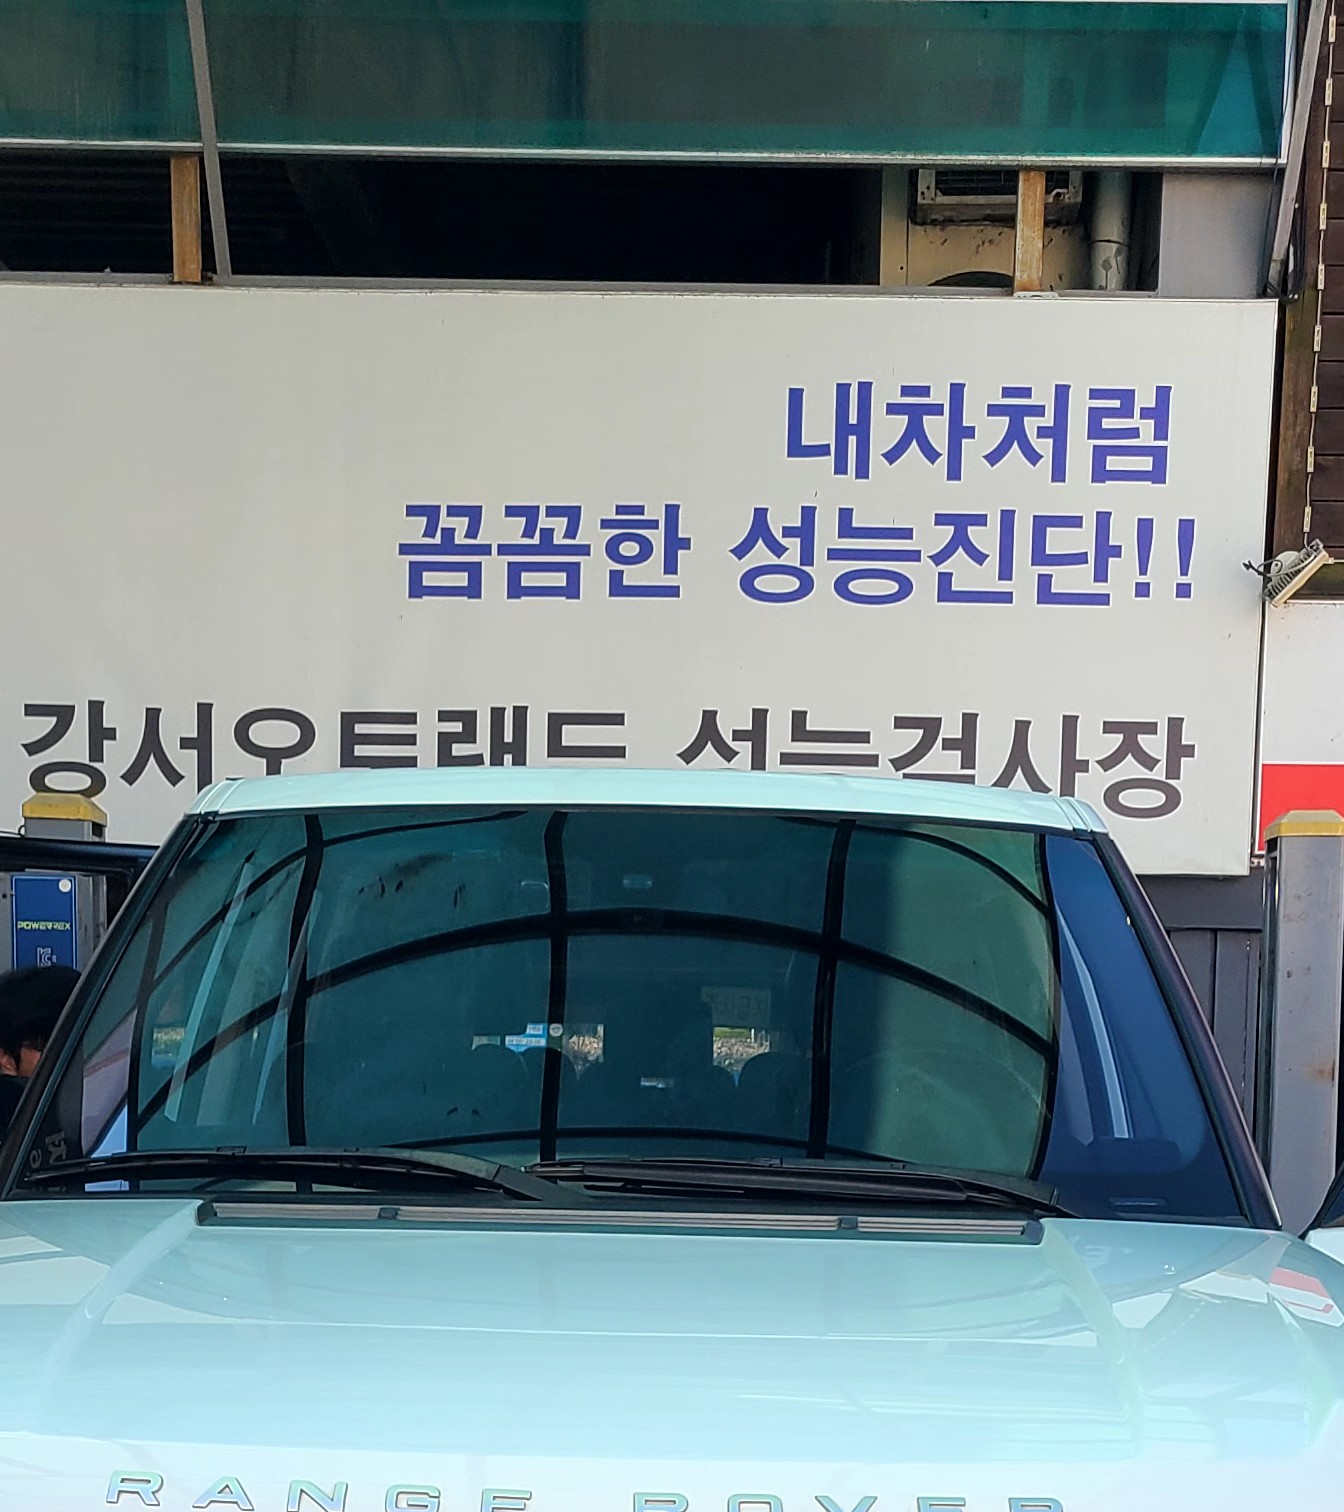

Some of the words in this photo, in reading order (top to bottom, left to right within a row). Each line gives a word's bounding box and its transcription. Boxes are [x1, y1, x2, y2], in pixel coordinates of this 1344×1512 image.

[785, 380, 1173, 486] 내차처럼
[396, 502, 692, 602] 꼼꼼한
[729, 505, 1198, 608] 성능진단!!
